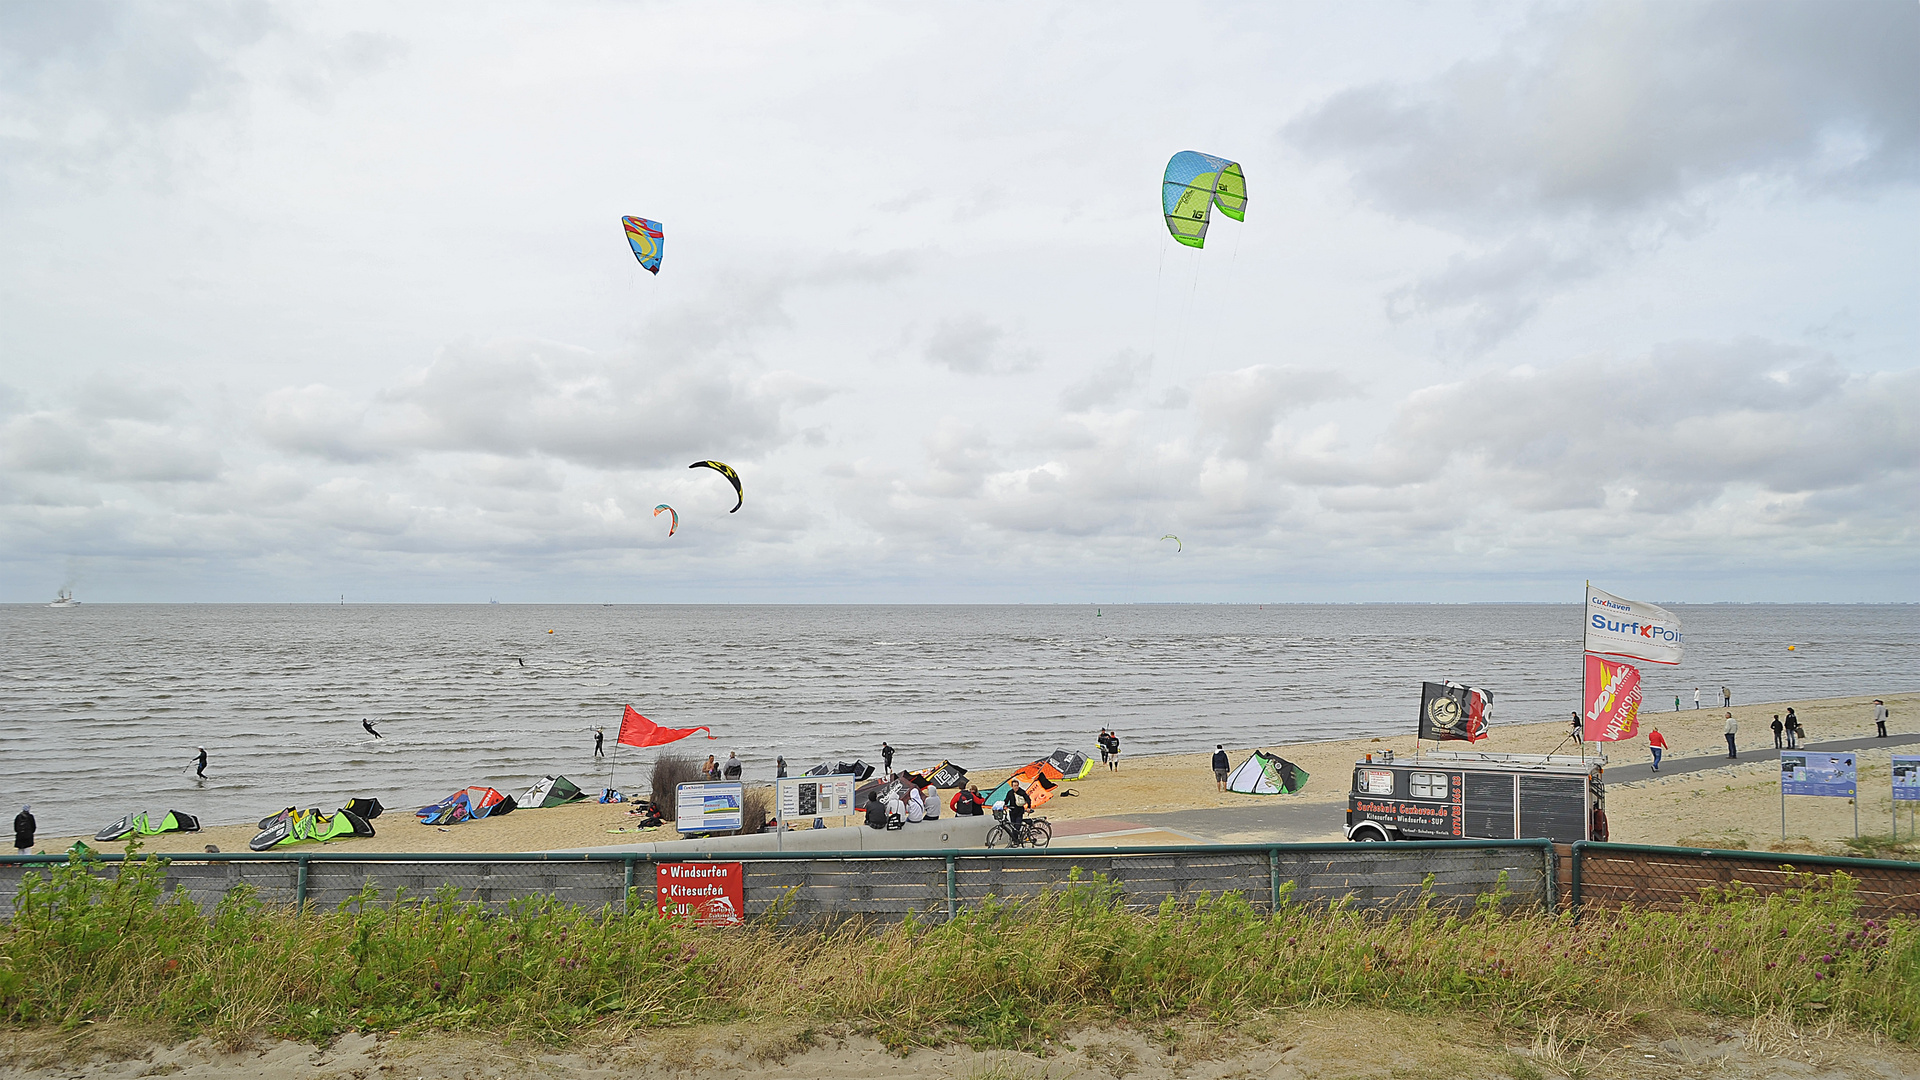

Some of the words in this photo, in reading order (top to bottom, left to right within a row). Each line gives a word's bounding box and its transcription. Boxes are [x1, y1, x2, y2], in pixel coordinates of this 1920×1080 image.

[1592, 596, 1631, 612] Cuxhaven
[1620, 701, 1640, 733] CENTER
[934, 769, 950, 785] 12
[1357, 801, 1397, 813] Surfschule
[1400, 804, 1448, 817] Cuxhaven.de
[1366, 812, 1393, 822] Kitesurfen
[1397, 815, 1427, 824] Windsurfen
[1431, 817, 1444, 826] SUP
[670, 865, 727, 878] Windsurfen
[671, 883, 723, 896] Kitesurfen
